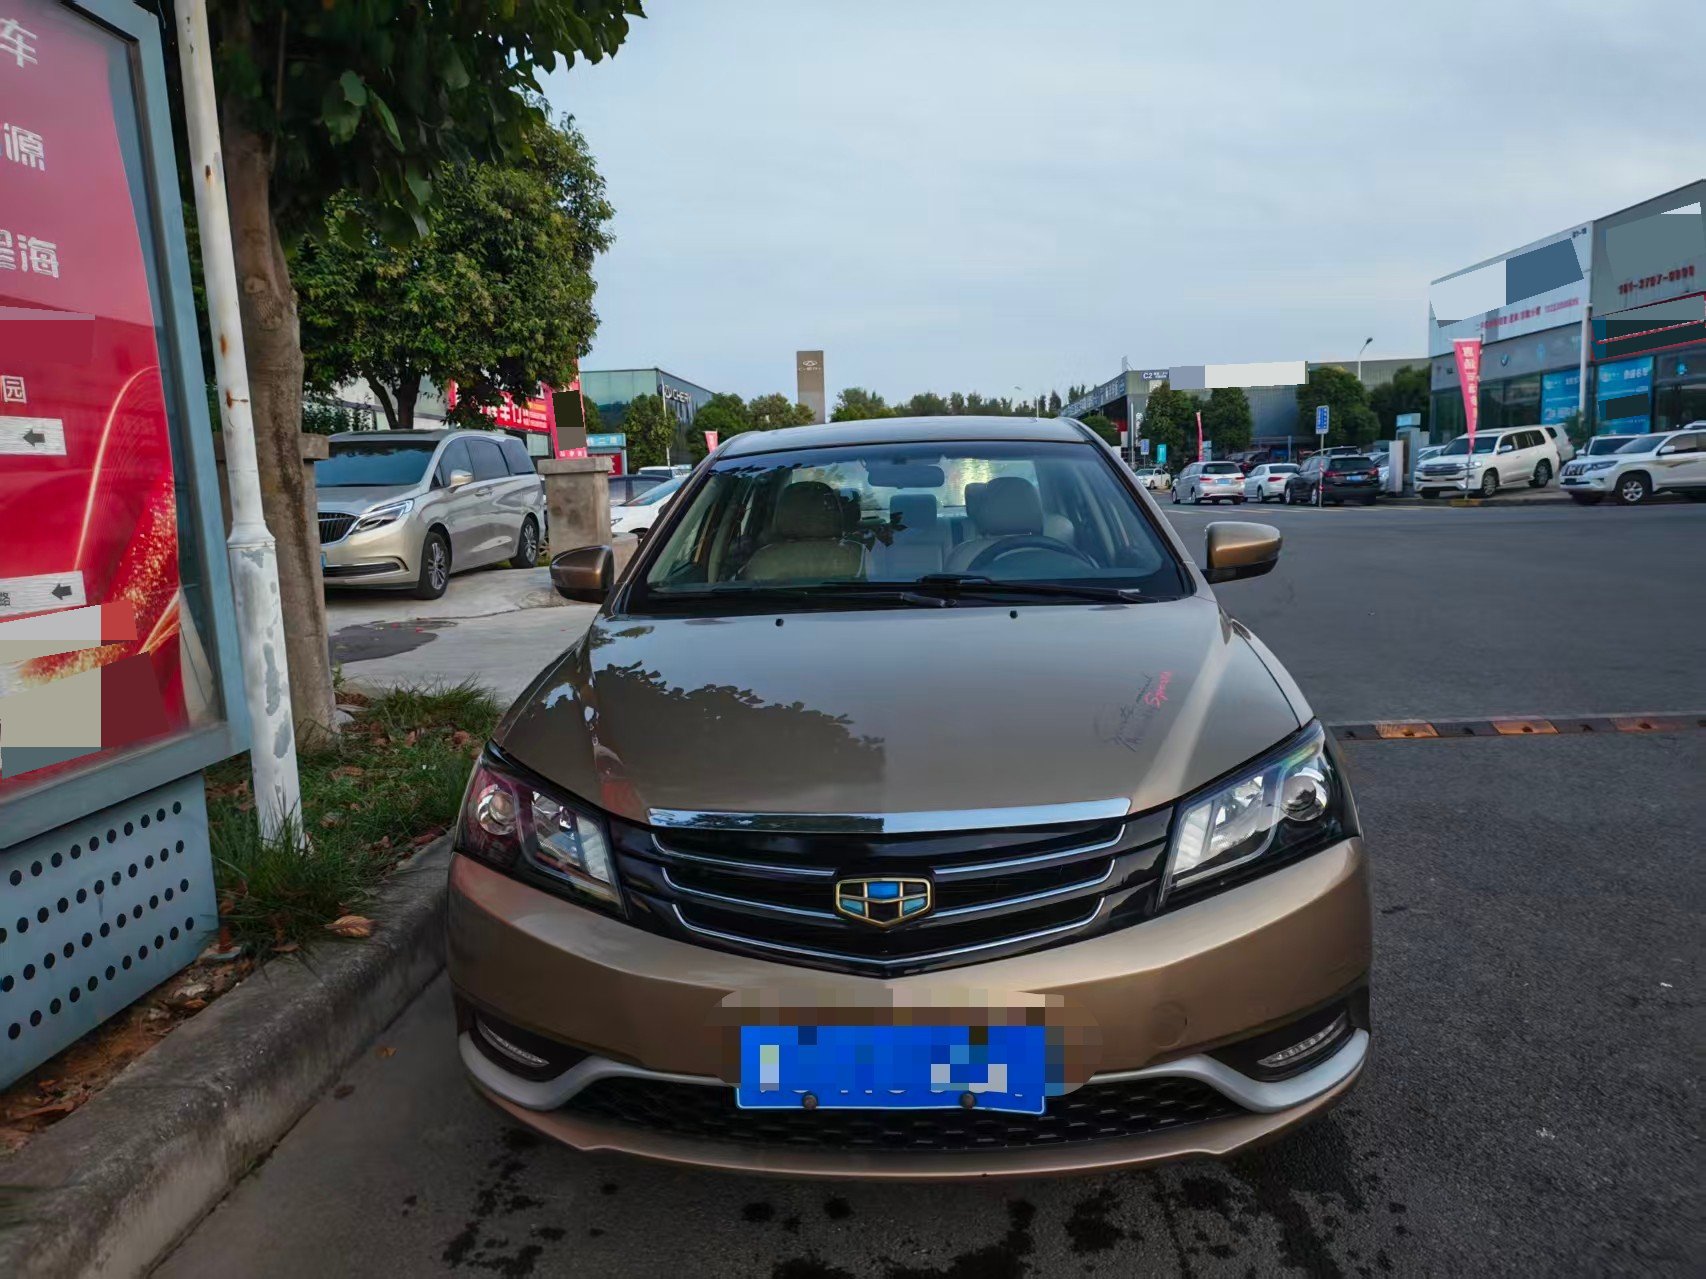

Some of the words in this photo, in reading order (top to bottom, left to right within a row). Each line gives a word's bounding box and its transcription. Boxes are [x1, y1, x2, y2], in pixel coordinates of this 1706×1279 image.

[0, 17, 38, 68] 车
[3, 122, 46, 172] 源
[1, 375, 27, 404] 园
